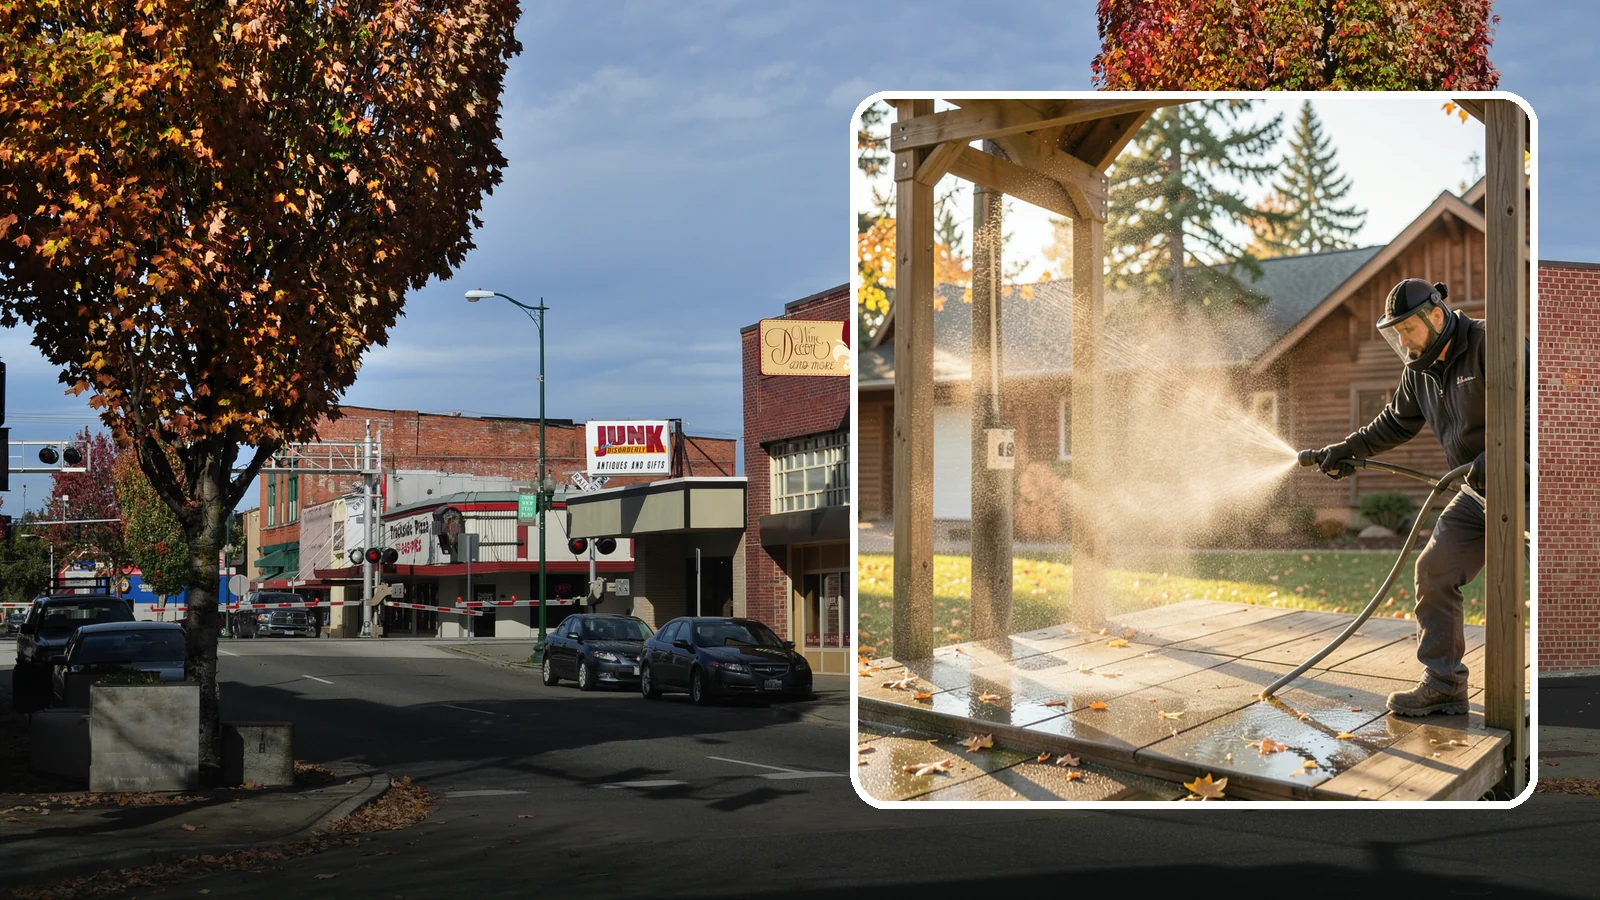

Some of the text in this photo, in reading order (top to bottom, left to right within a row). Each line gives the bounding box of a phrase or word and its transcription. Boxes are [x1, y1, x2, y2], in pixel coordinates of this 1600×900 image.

[595, 425, 665, 457] JUNK
[607, 446, 645, 455] DISORDERLY
[596, 460, 665, 470] ANTIQUES AND GIFTS
[390, 519, 429, 539] Trackside Pizza
